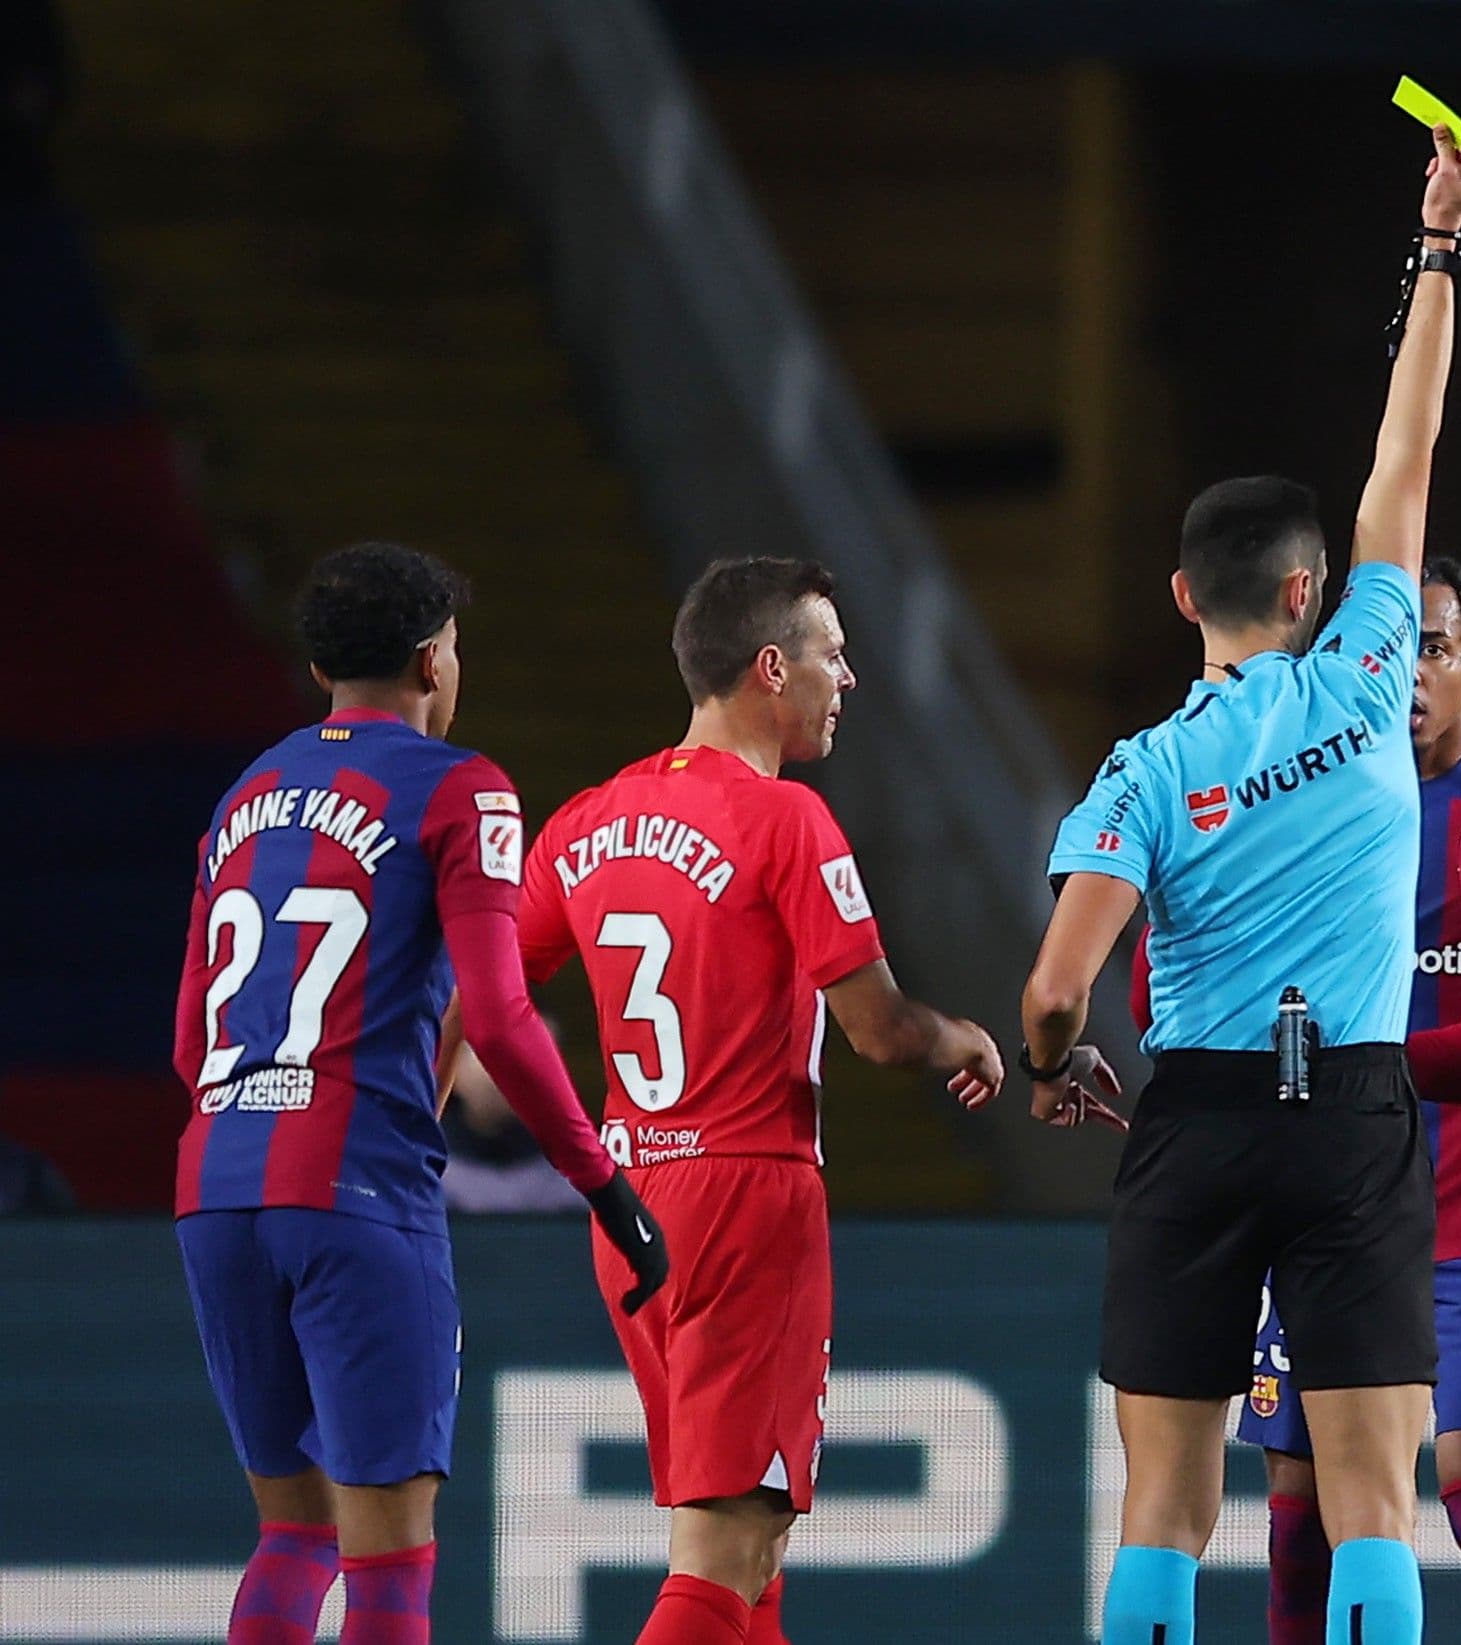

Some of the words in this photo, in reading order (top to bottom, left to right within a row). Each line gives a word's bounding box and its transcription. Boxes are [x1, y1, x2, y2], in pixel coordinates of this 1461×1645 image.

[1234, 720, 1373, 810] WÜRTH
[207, 788, 302, 883] LAMINE
[301, 788, 398, 877] YAMAL
[553, 814, 735, 903] AZPILICUETA
[197, 887, 369, 1089] 27
[596, 913, 686, 1112] 3
[237, 1086, 313, 1105] ACNUR
[244, 1067, 315, 1088] UNHCR
[636, 1125, 702, 1148] Money
